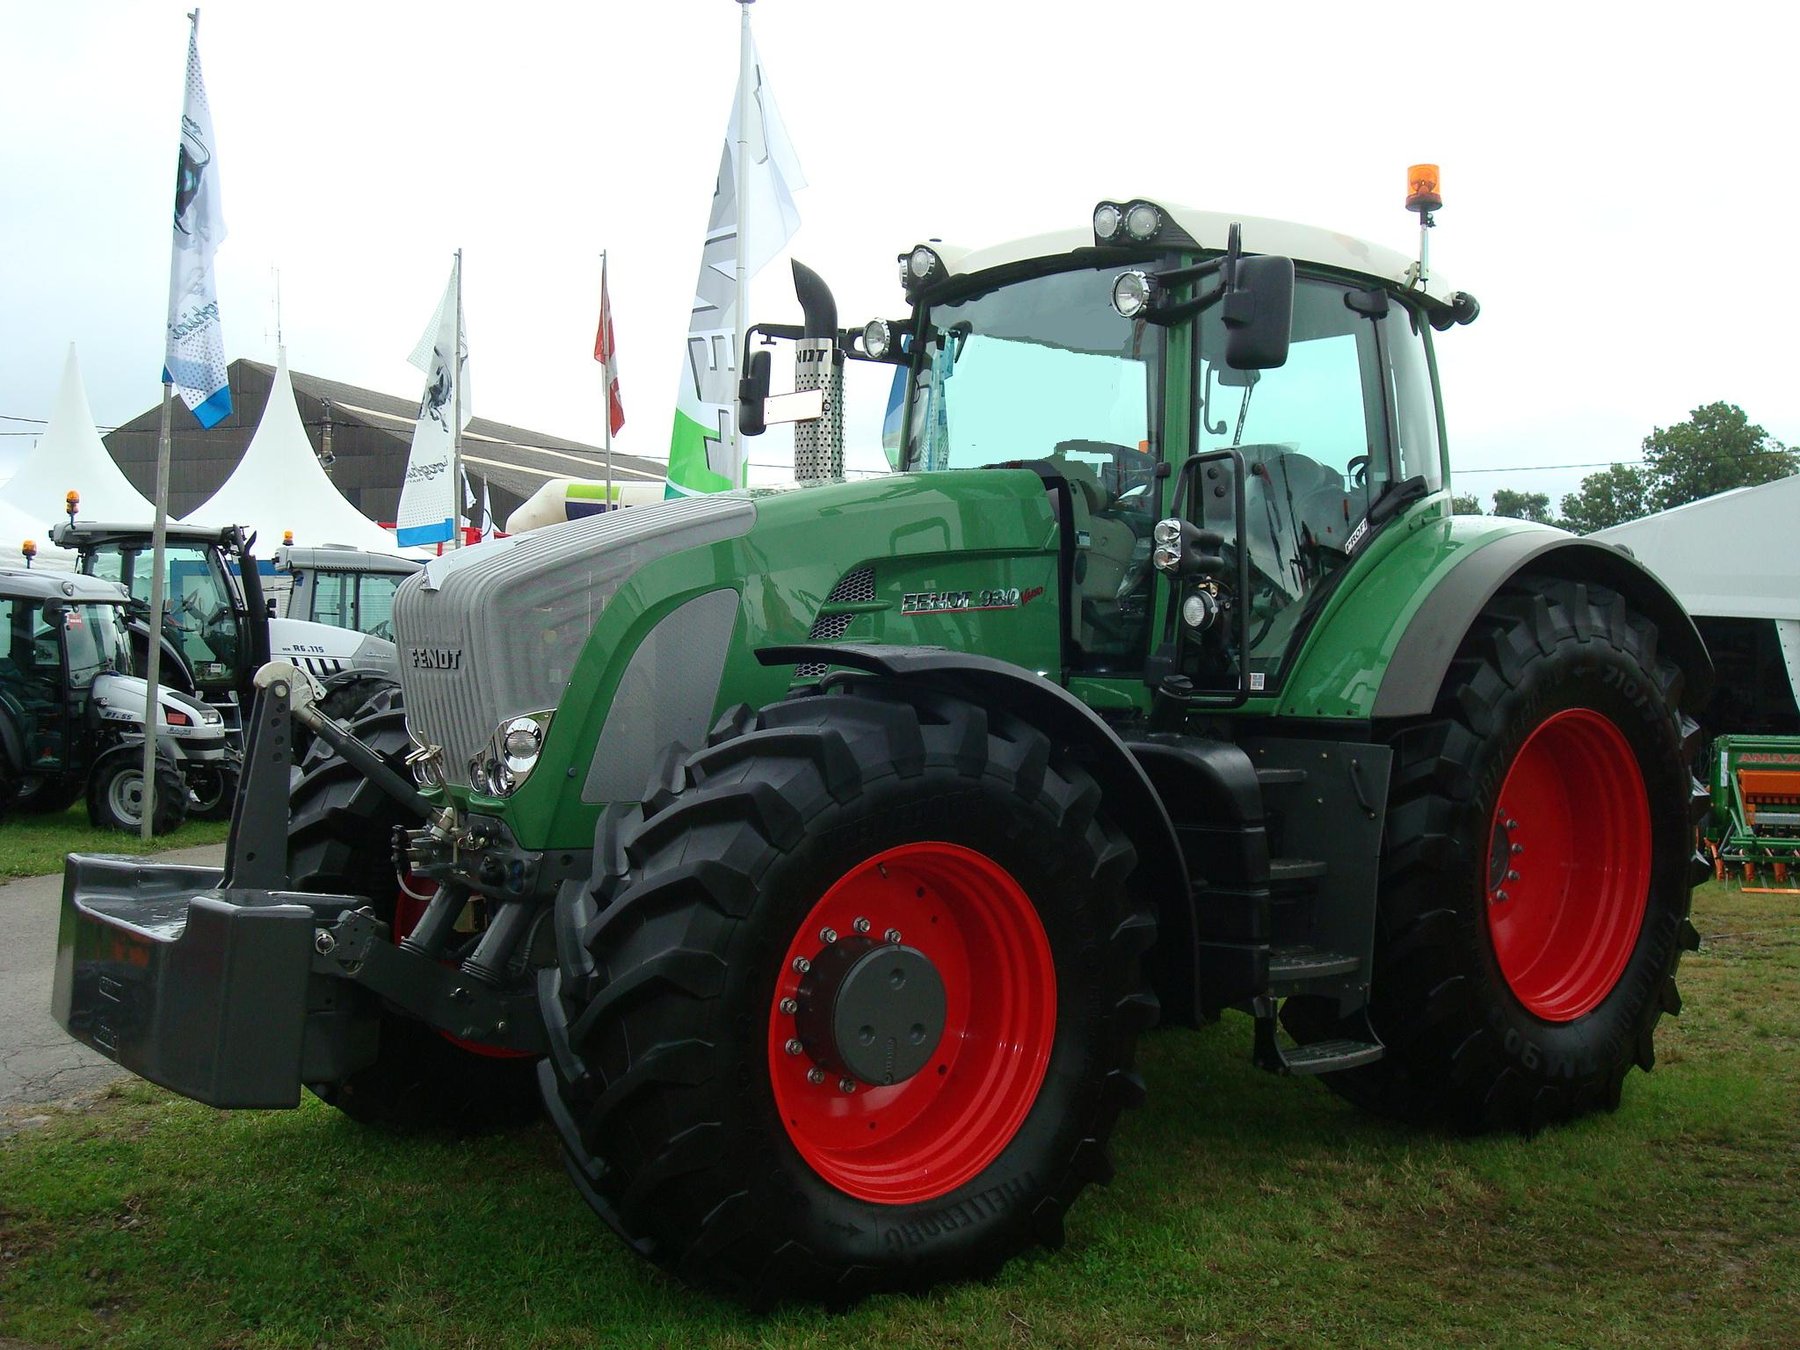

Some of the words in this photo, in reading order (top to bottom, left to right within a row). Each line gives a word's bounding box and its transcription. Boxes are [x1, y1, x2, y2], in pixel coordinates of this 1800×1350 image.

[1346, 520, 1367, 551] PROFI
[902, 591, 973, 612] FENDT
[980, 587, 1020, 607] 930
[293, 644, 325, 653] R6.115
[409, 648, 462, 670] FENDT
